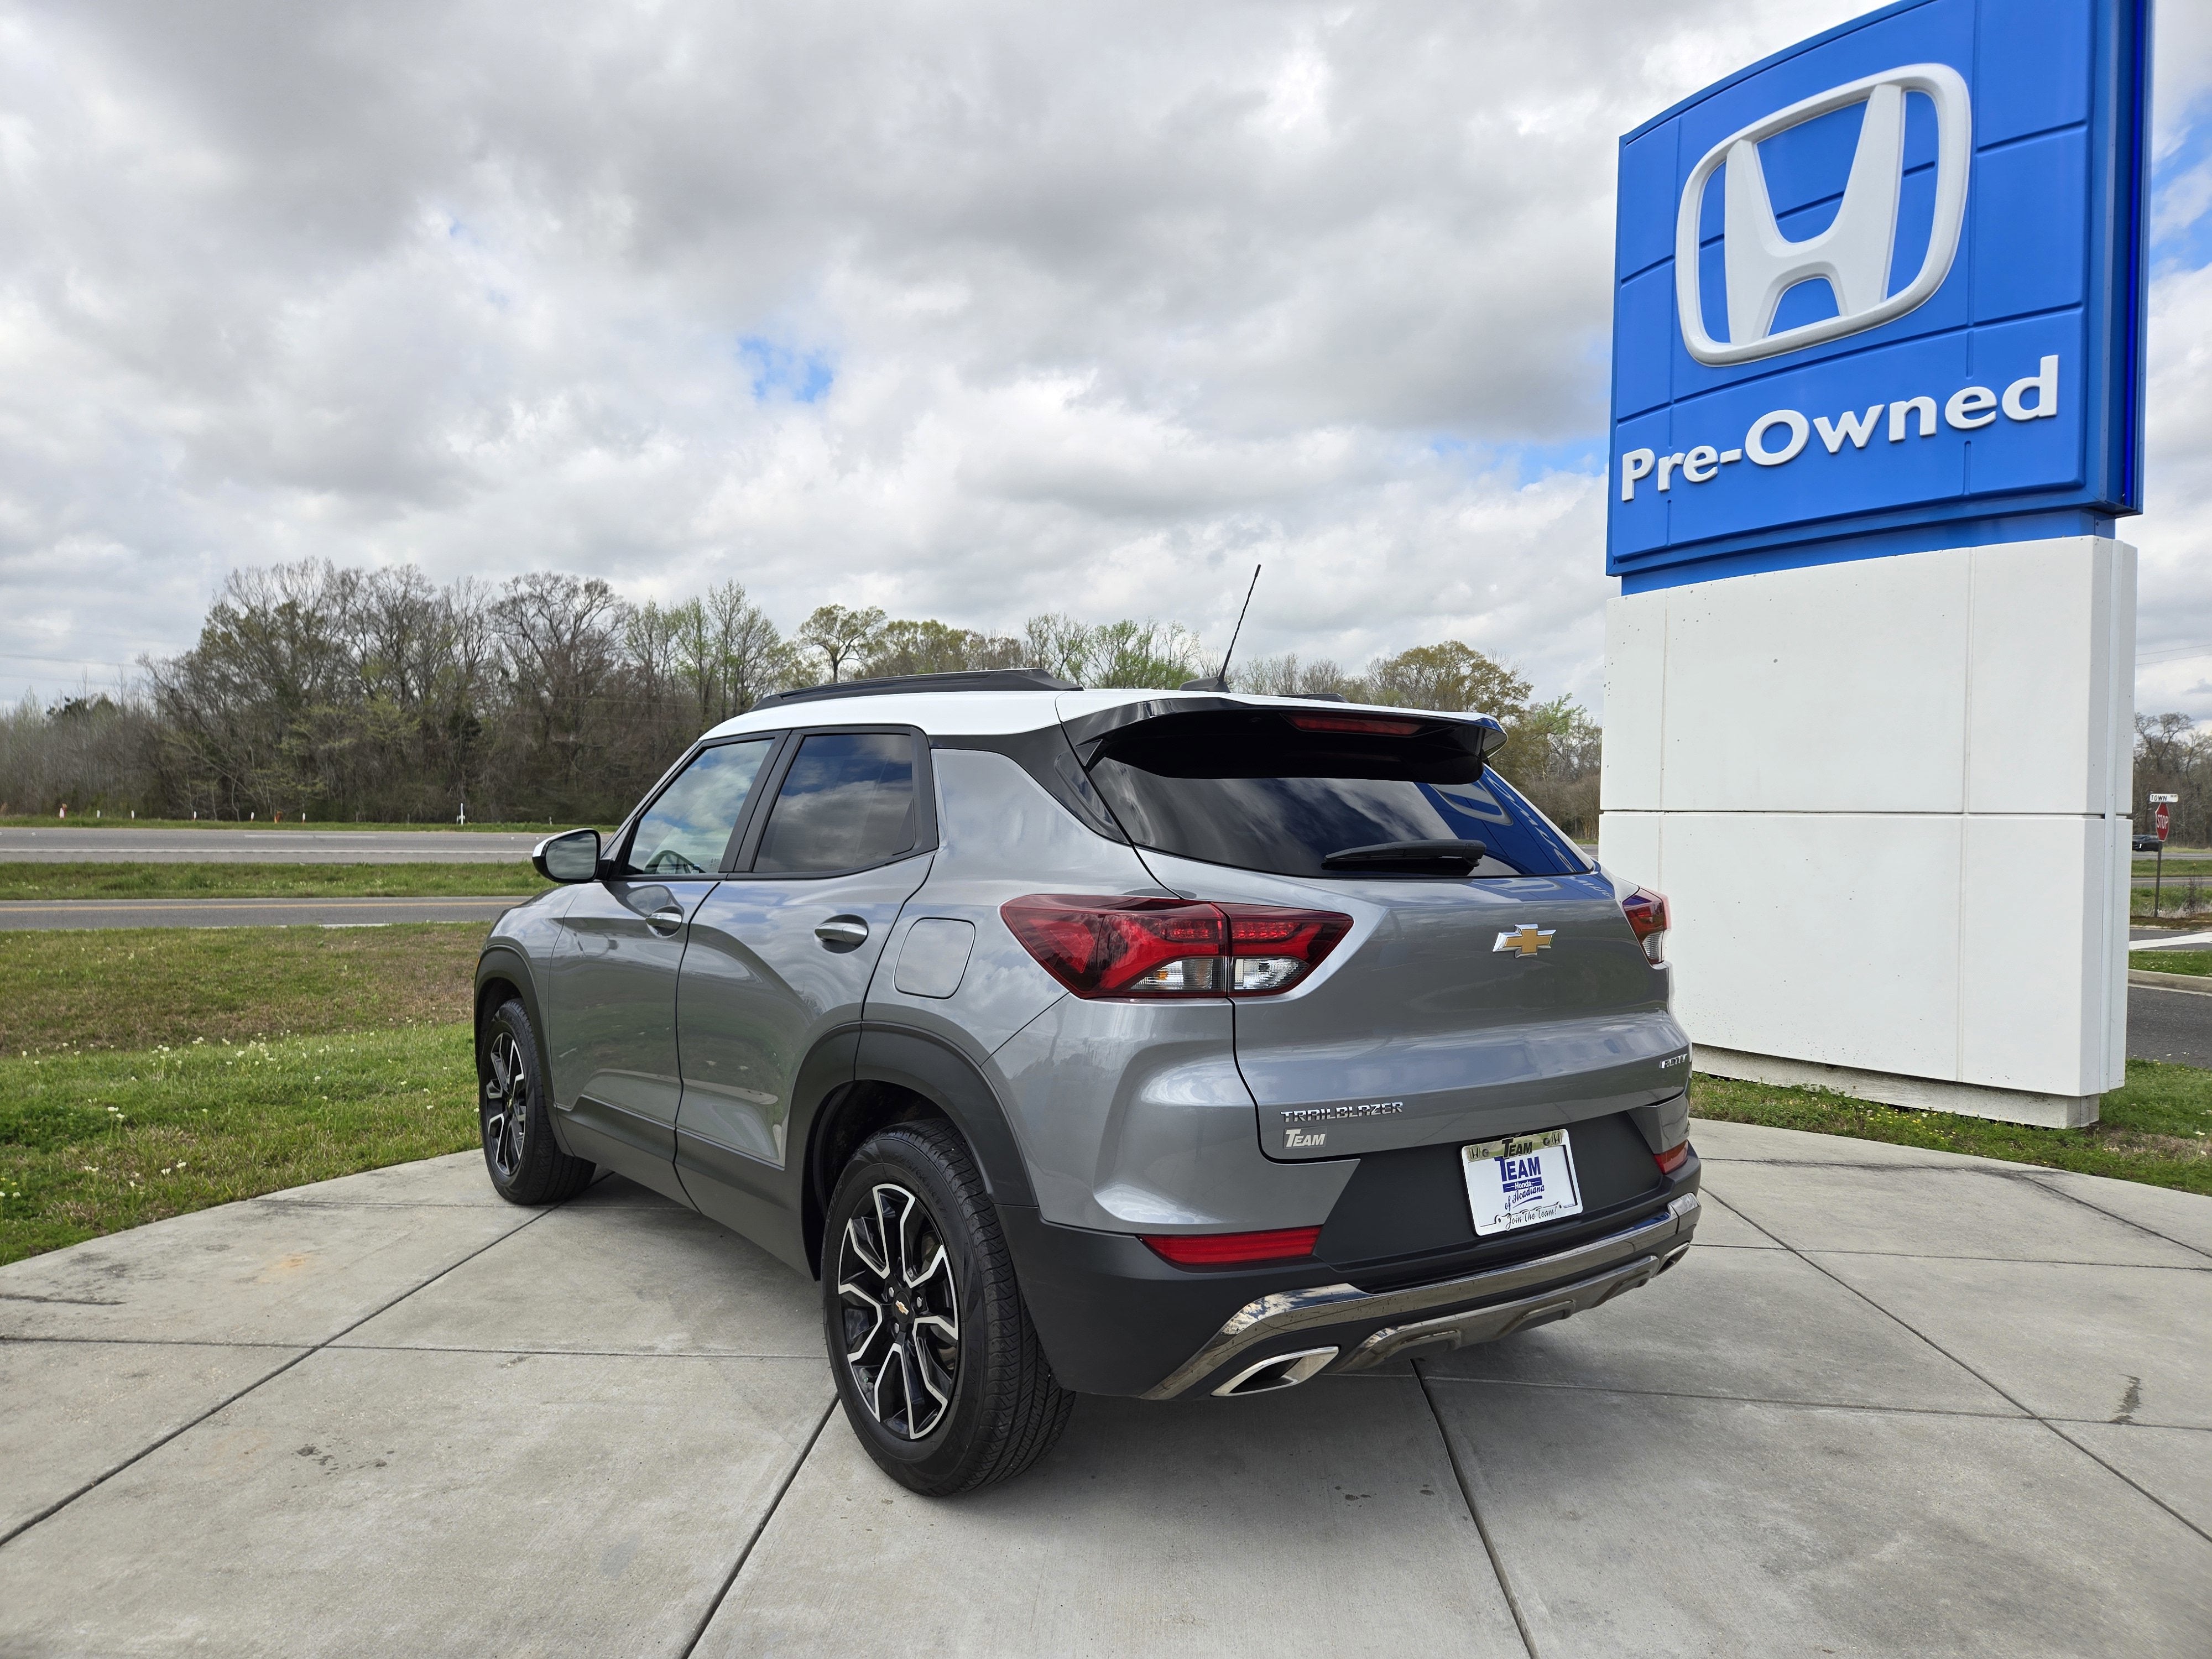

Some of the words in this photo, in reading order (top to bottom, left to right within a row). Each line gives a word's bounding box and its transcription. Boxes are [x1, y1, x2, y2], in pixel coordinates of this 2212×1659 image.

[1621, 354, 2059, 502] Pre-Owned
[2157, 814, 2168, 829] STOP
[1280, 1102, 1404, 1123] TRAILBLAZER
[1285, 1129, 1326, 1147] TEAM
[1501, 1139, 1532, 1157] TEAM
[1494, 1156, 1541, 1182] TEAM
[1515, 1180, 1532, 1190] Honda
[1505, 1196, 1511, 1212] of
[1512, 1185, 1545, 1203] Acadiana
[1505, 1213, 1522, 1230] Join
[1522, 1209, 1535, 1222] The
[1536, 1206, 1557, 1219] Team!
